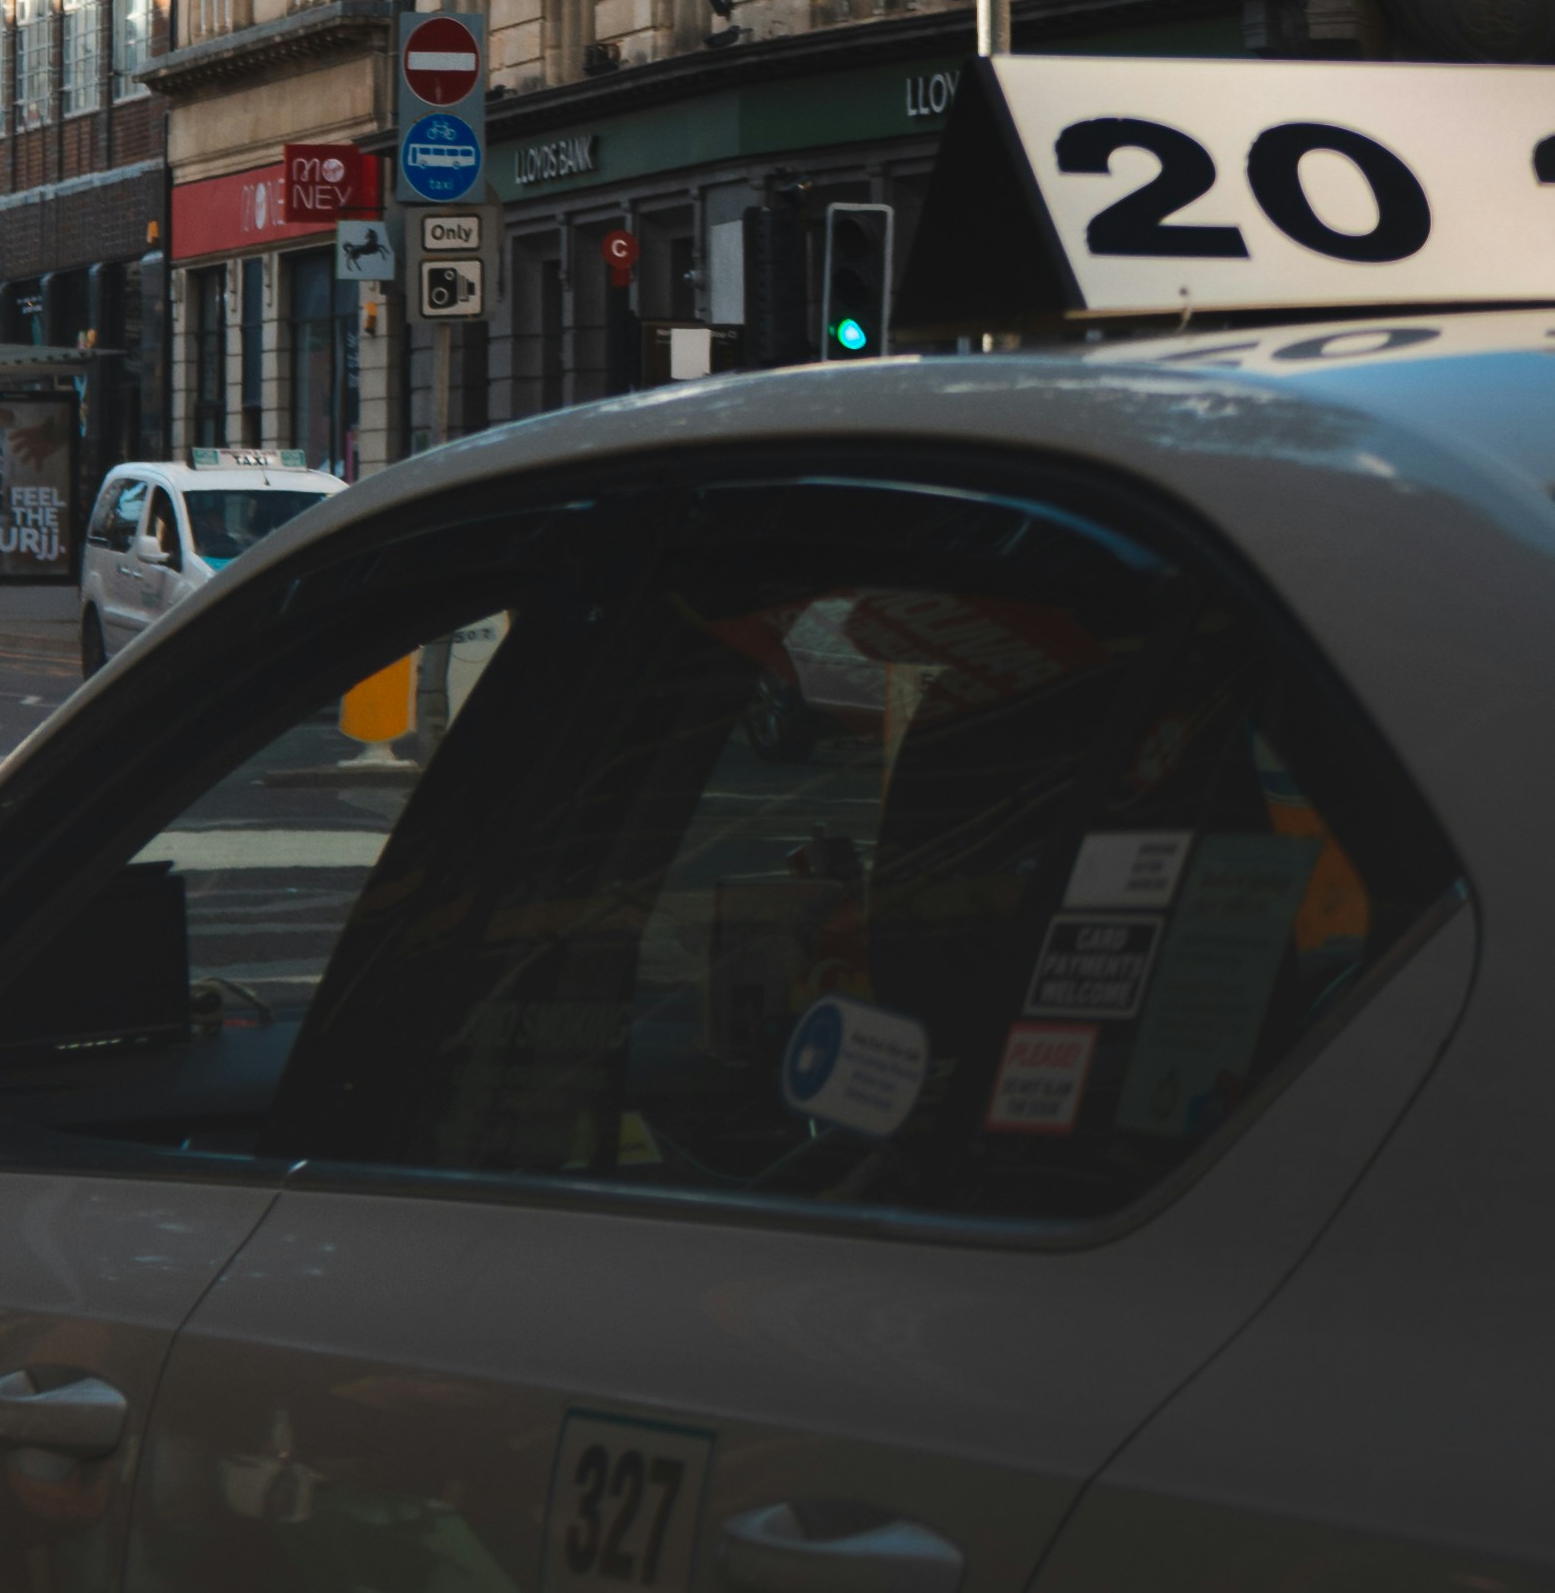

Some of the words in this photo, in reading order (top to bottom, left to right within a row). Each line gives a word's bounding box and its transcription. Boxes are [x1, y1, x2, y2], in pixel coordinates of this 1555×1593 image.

[514, 142, 557, 185] LLOYDS
[558, 134, 594, 176] BANK
[429, 179, 454, 190] taxi
[1054, 116, 1434, 265] 20
[431, 223, 473, 242] Only
[610, 239, 629, 258] C
[10, 485, 67, 508] FEEL
[11, 508, 59, 527] THE
[1074, 926, 1132, 951] CARD
[1043, 951, 1147, 979] PAYMENTS
[1037, 979, 1135, 1008] WELCOME
[564, 1441, 686, 1587] 327
